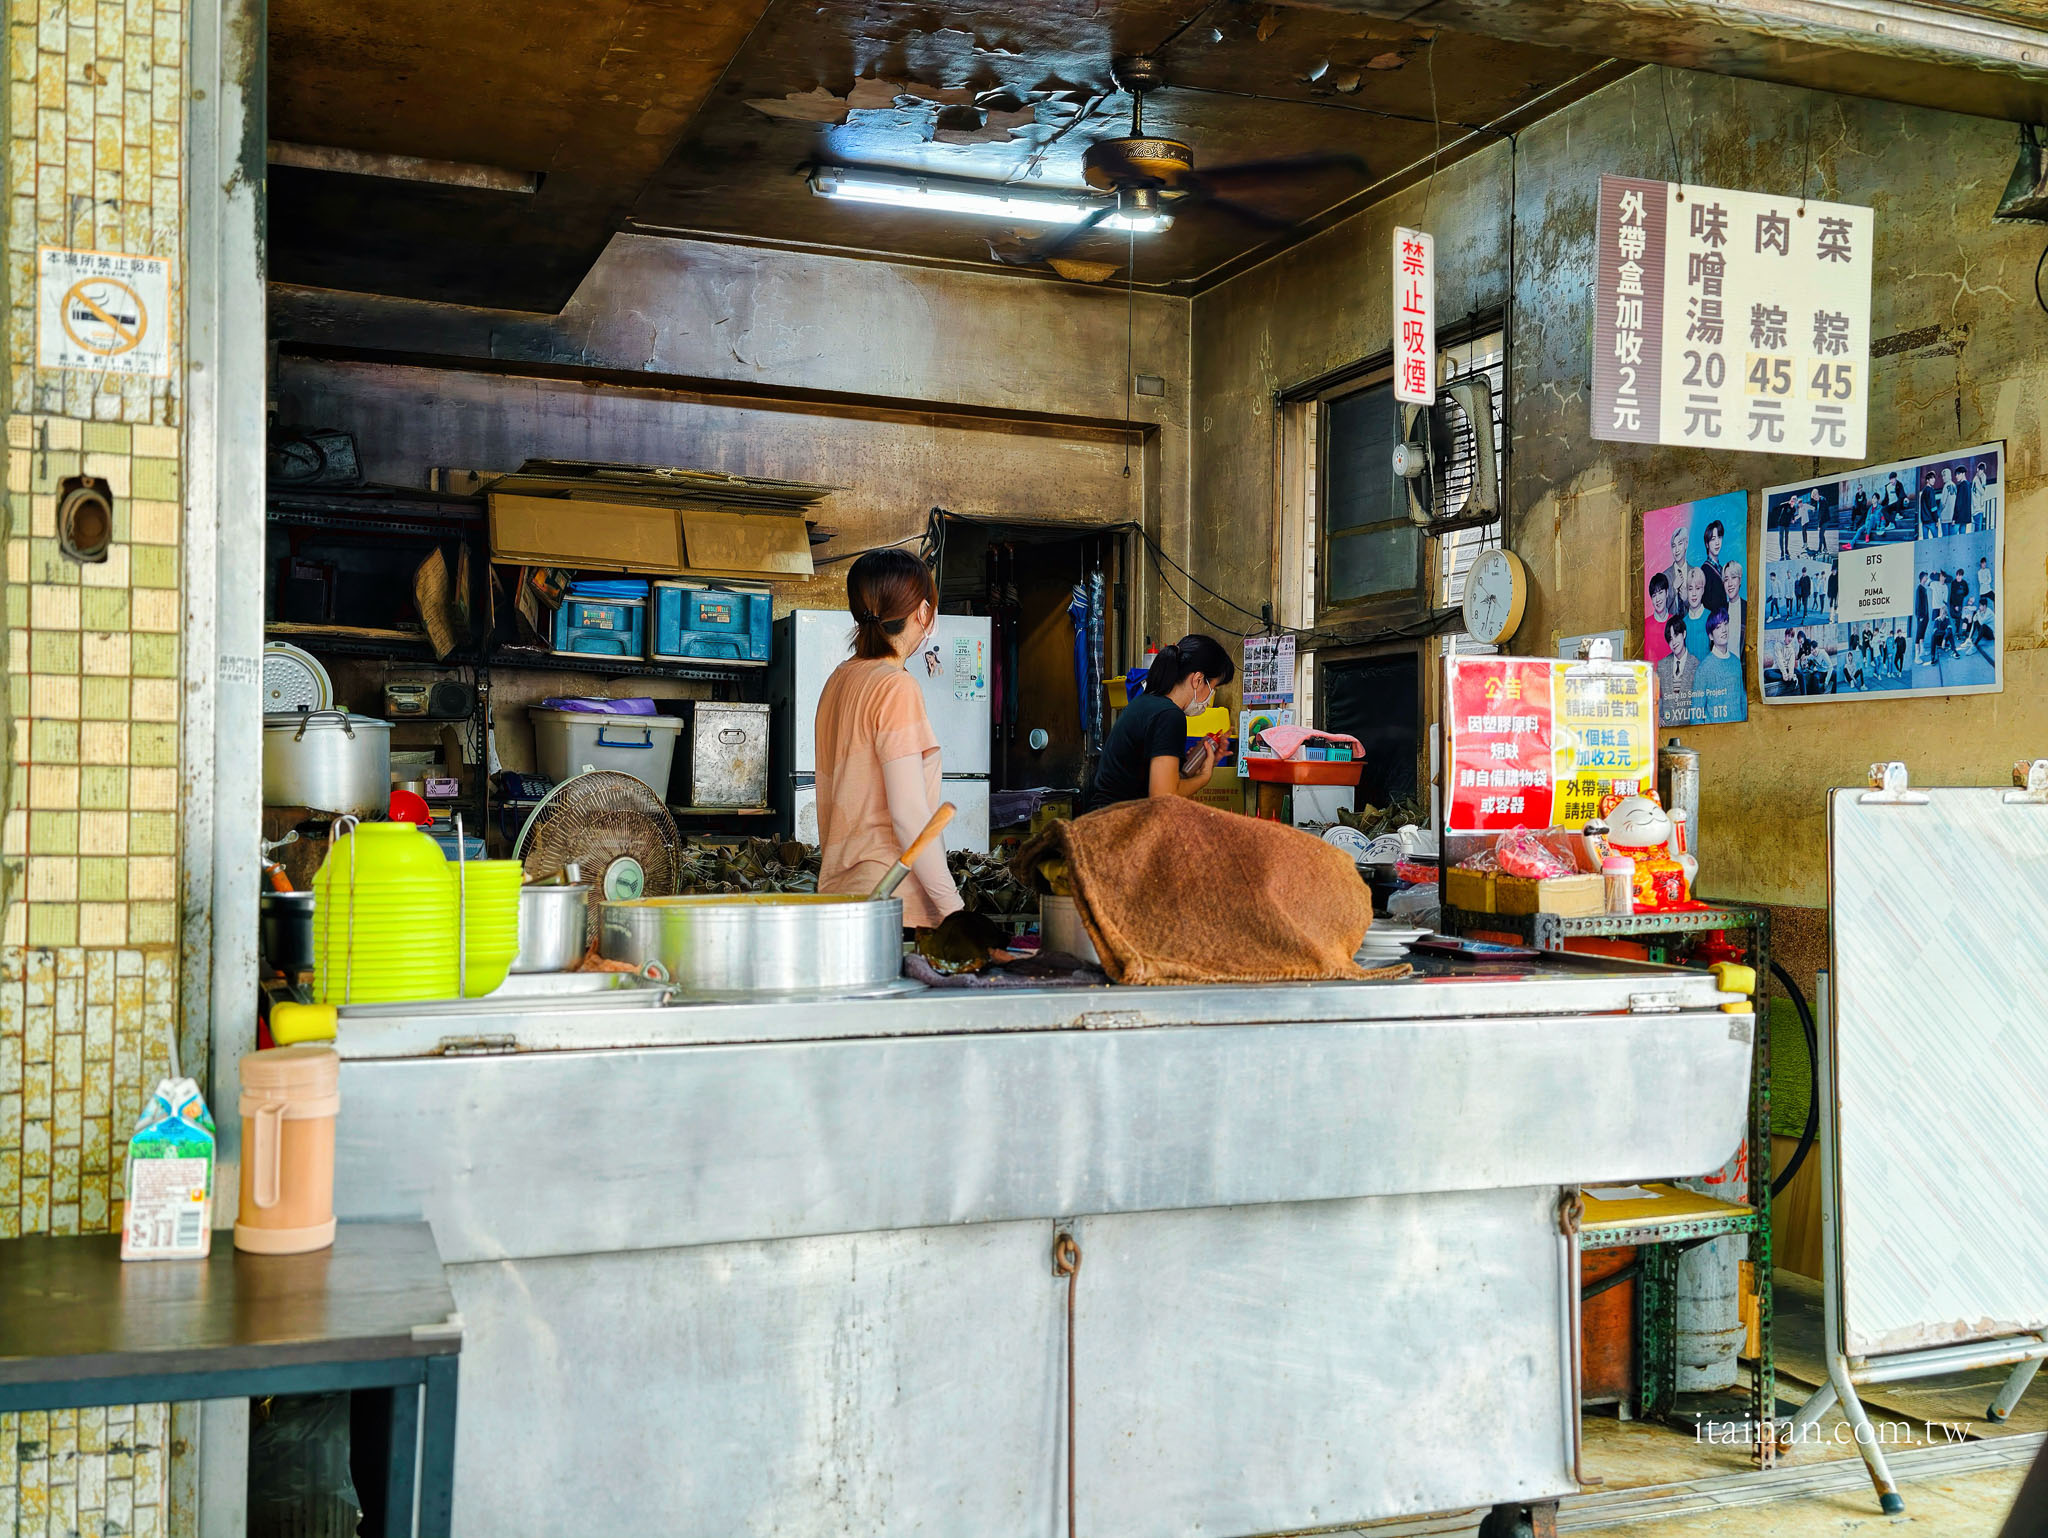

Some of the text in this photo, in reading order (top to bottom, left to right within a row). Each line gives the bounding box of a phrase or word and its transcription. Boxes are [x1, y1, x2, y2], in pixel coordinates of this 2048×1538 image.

[1402, 239, 1426, 394] 禁止吸煙
[1612, 190, 1648, 431] 外帶盒加收2元
[1682, 202, 1728, 438] 味噌湯20元
[1747, 209, 1791, 442] 肉粽45元
[1810, 216, 1853, 447] 菜粽45元
[1866, 554, 1883, 566] BTS
[1864, 587, 1883, 596] PUMA
[1859, 596, 1891, 607] BOG SOCK
[1484, 677, 1522, 700] 公告
[1688, 690, 1705, 698] Smile
[1706, 688, 1728, 697] Project
[1565, 699, 1639, 717] 請提前告知
[1672, 705, 1728, 720] XYLITOL BTS
[1467, 715, 1539, 733] 因塑膠原料
[1576, 729, 1630, 747] 1個紙盒
[1490, 742, 1519, 760] 短缺
[1575, 749, 1631, 767] 加收2元
[1480, 796, 1525, 814] 或容器
[1564, 802, 1601, 820] 請提
